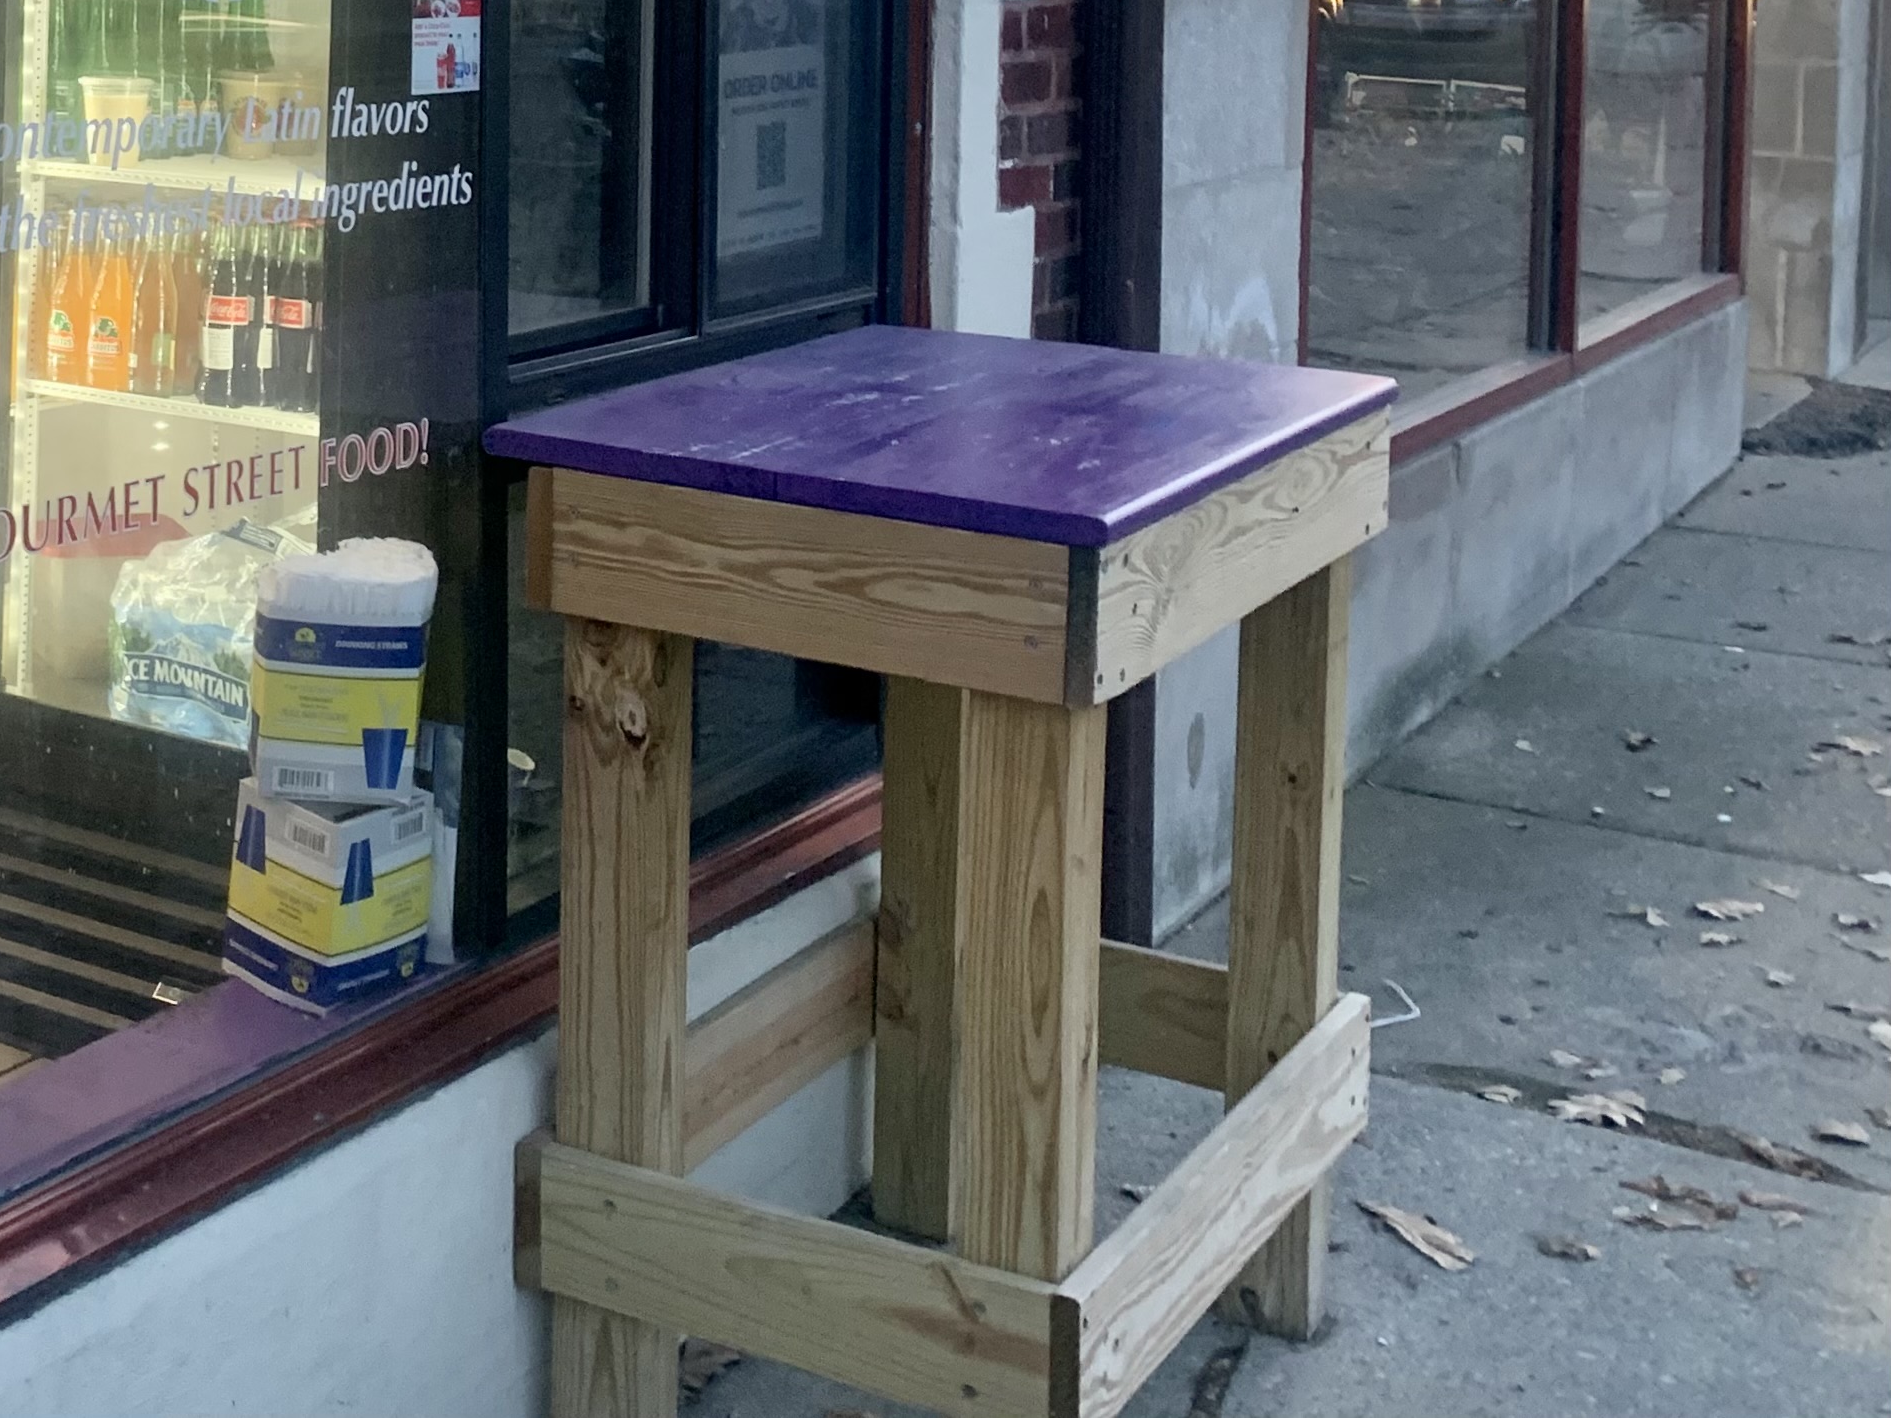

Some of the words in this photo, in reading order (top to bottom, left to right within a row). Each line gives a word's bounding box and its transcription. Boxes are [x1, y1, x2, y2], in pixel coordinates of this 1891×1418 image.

[243, 95, 321, 144] Latin
[331, 85, 430, 141] flavors
[223, 169, 304, 226] local
[311, 160, 474, 232] ingredients
[183, 445, 308, 518] STREET
[319, 417, 432, 488] FOOD!
[154, 658, 244, 708] MOUNTAIN
